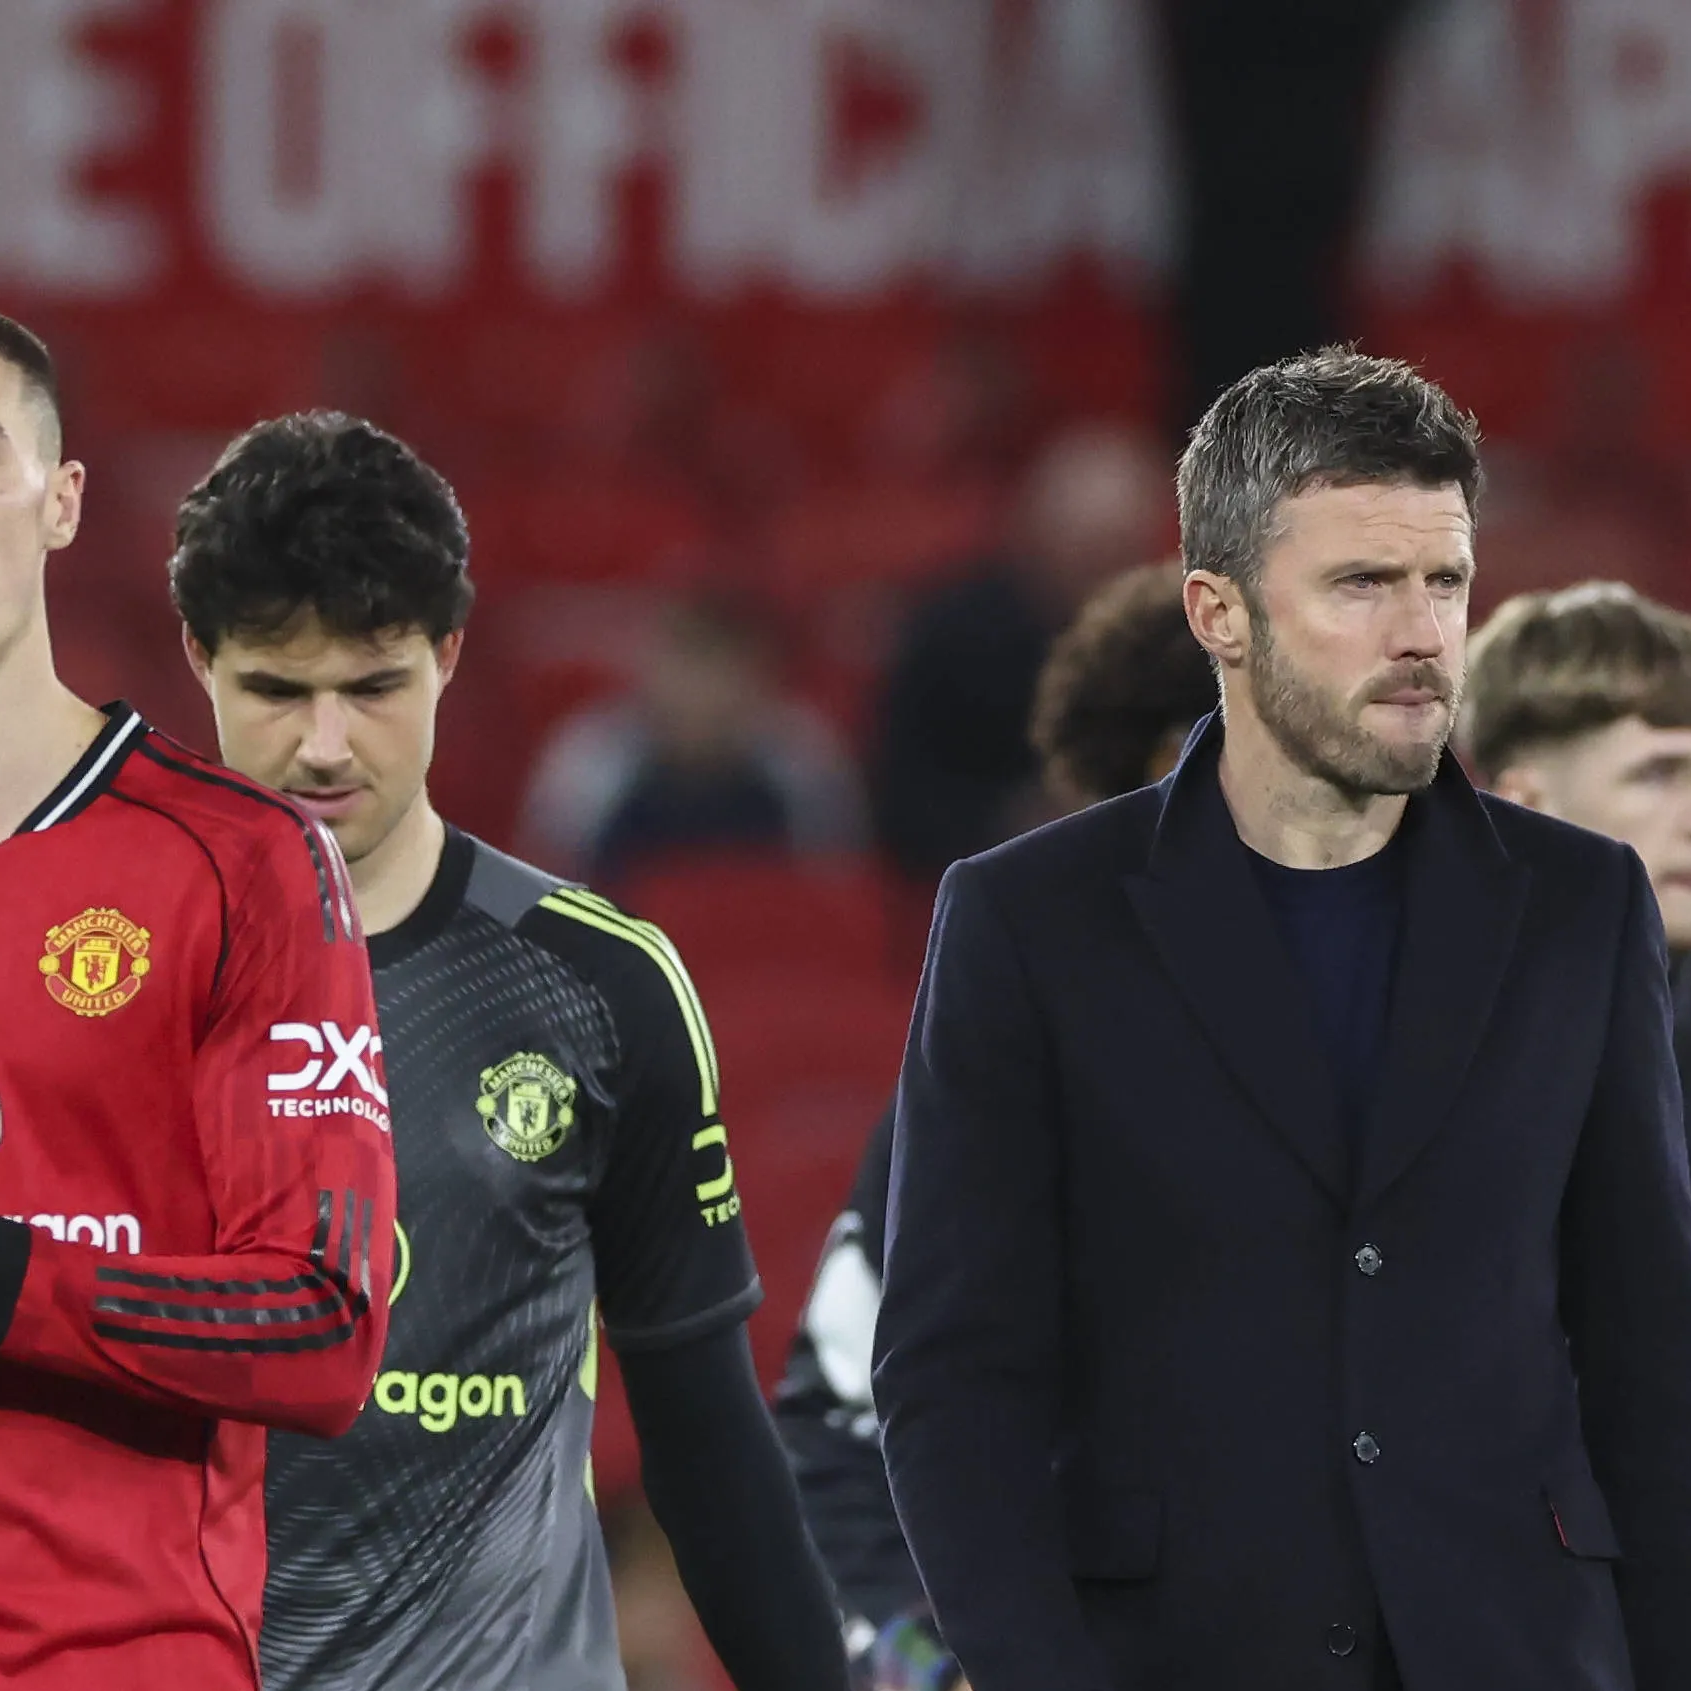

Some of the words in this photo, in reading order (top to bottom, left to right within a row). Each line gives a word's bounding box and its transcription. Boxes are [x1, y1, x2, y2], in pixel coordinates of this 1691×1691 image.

[198, 0, 1182, 295] OFFICIA
[53, 916, 143, 951] MANCHESTER
[61, 988, 127, 1009] UNITED
[373, 1370, 527, 1433] agon
